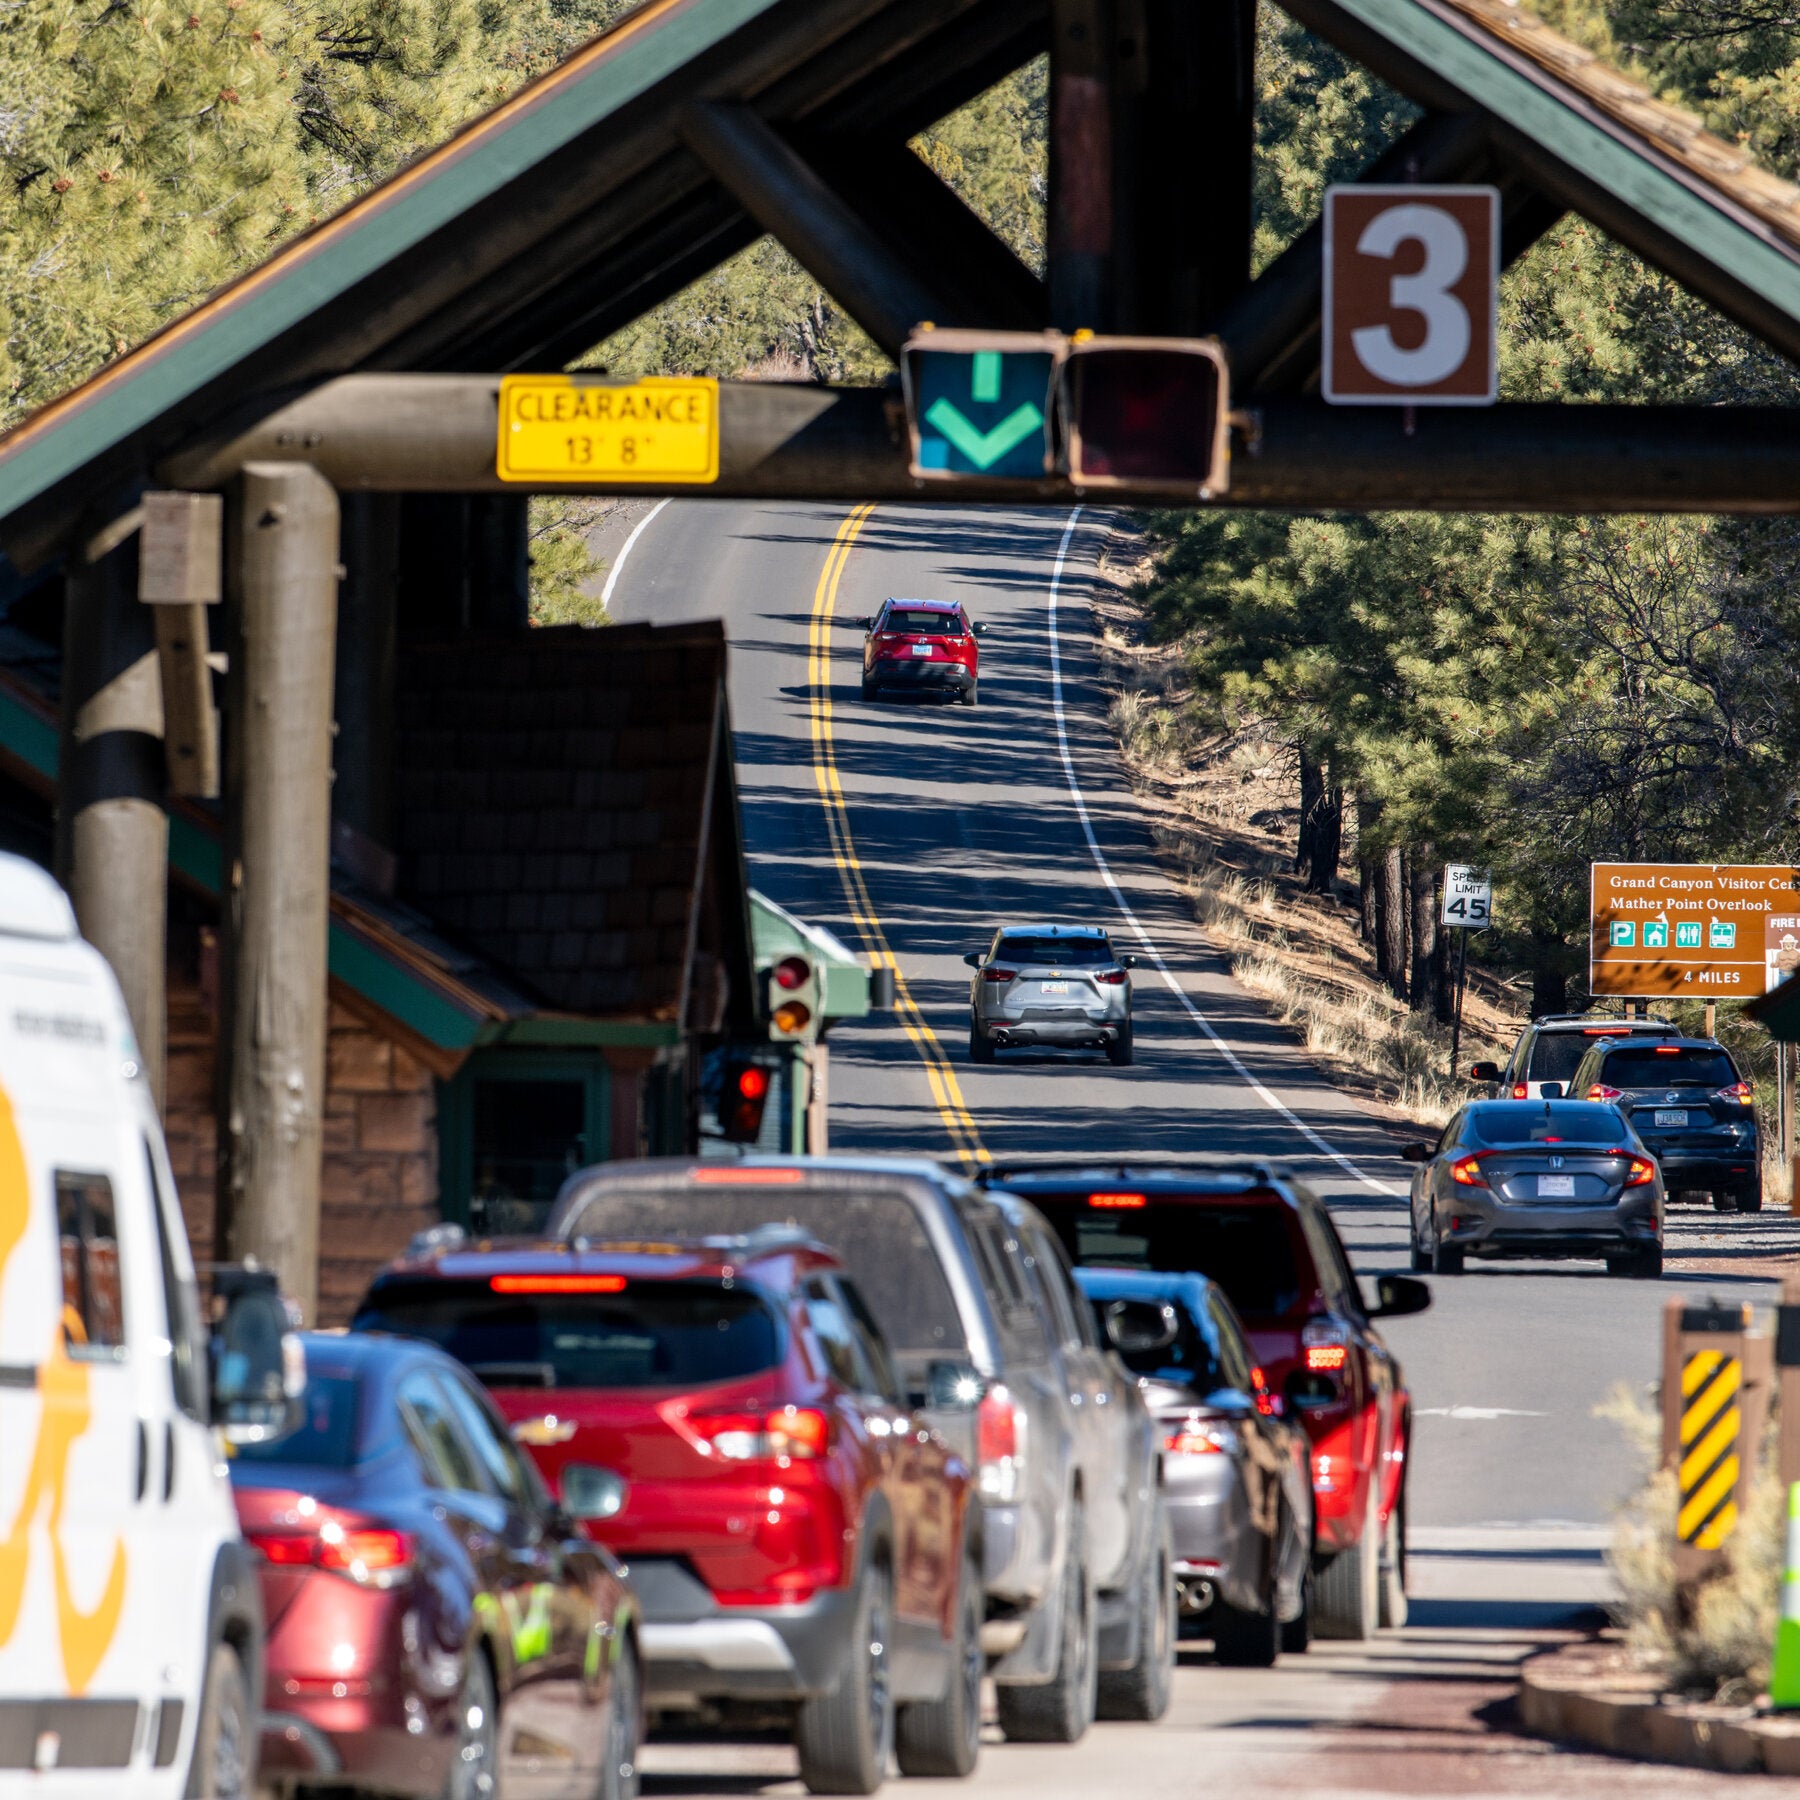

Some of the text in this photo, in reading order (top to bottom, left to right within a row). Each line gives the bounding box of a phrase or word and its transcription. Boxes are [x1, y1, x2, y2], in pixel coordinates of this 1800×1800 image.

[1351, 203, 1472, 387] 3
[516, 393, 700, 420] CLEARANCE
[1455, 884, 1483, 894] LIMIT
[1610, 876, 1655, 888] Grand
[1659, 876, 1714, 892] Canyon
[1717, 878, 1766, 890] Visitor
[1447, 897, 1486, 919] 45
[1610, 897, 1772, 911] Mather Point Overlook
[1770, 917, 1796, 928] FIRE
[1684, 971, 1741, 984] 4 MILES
